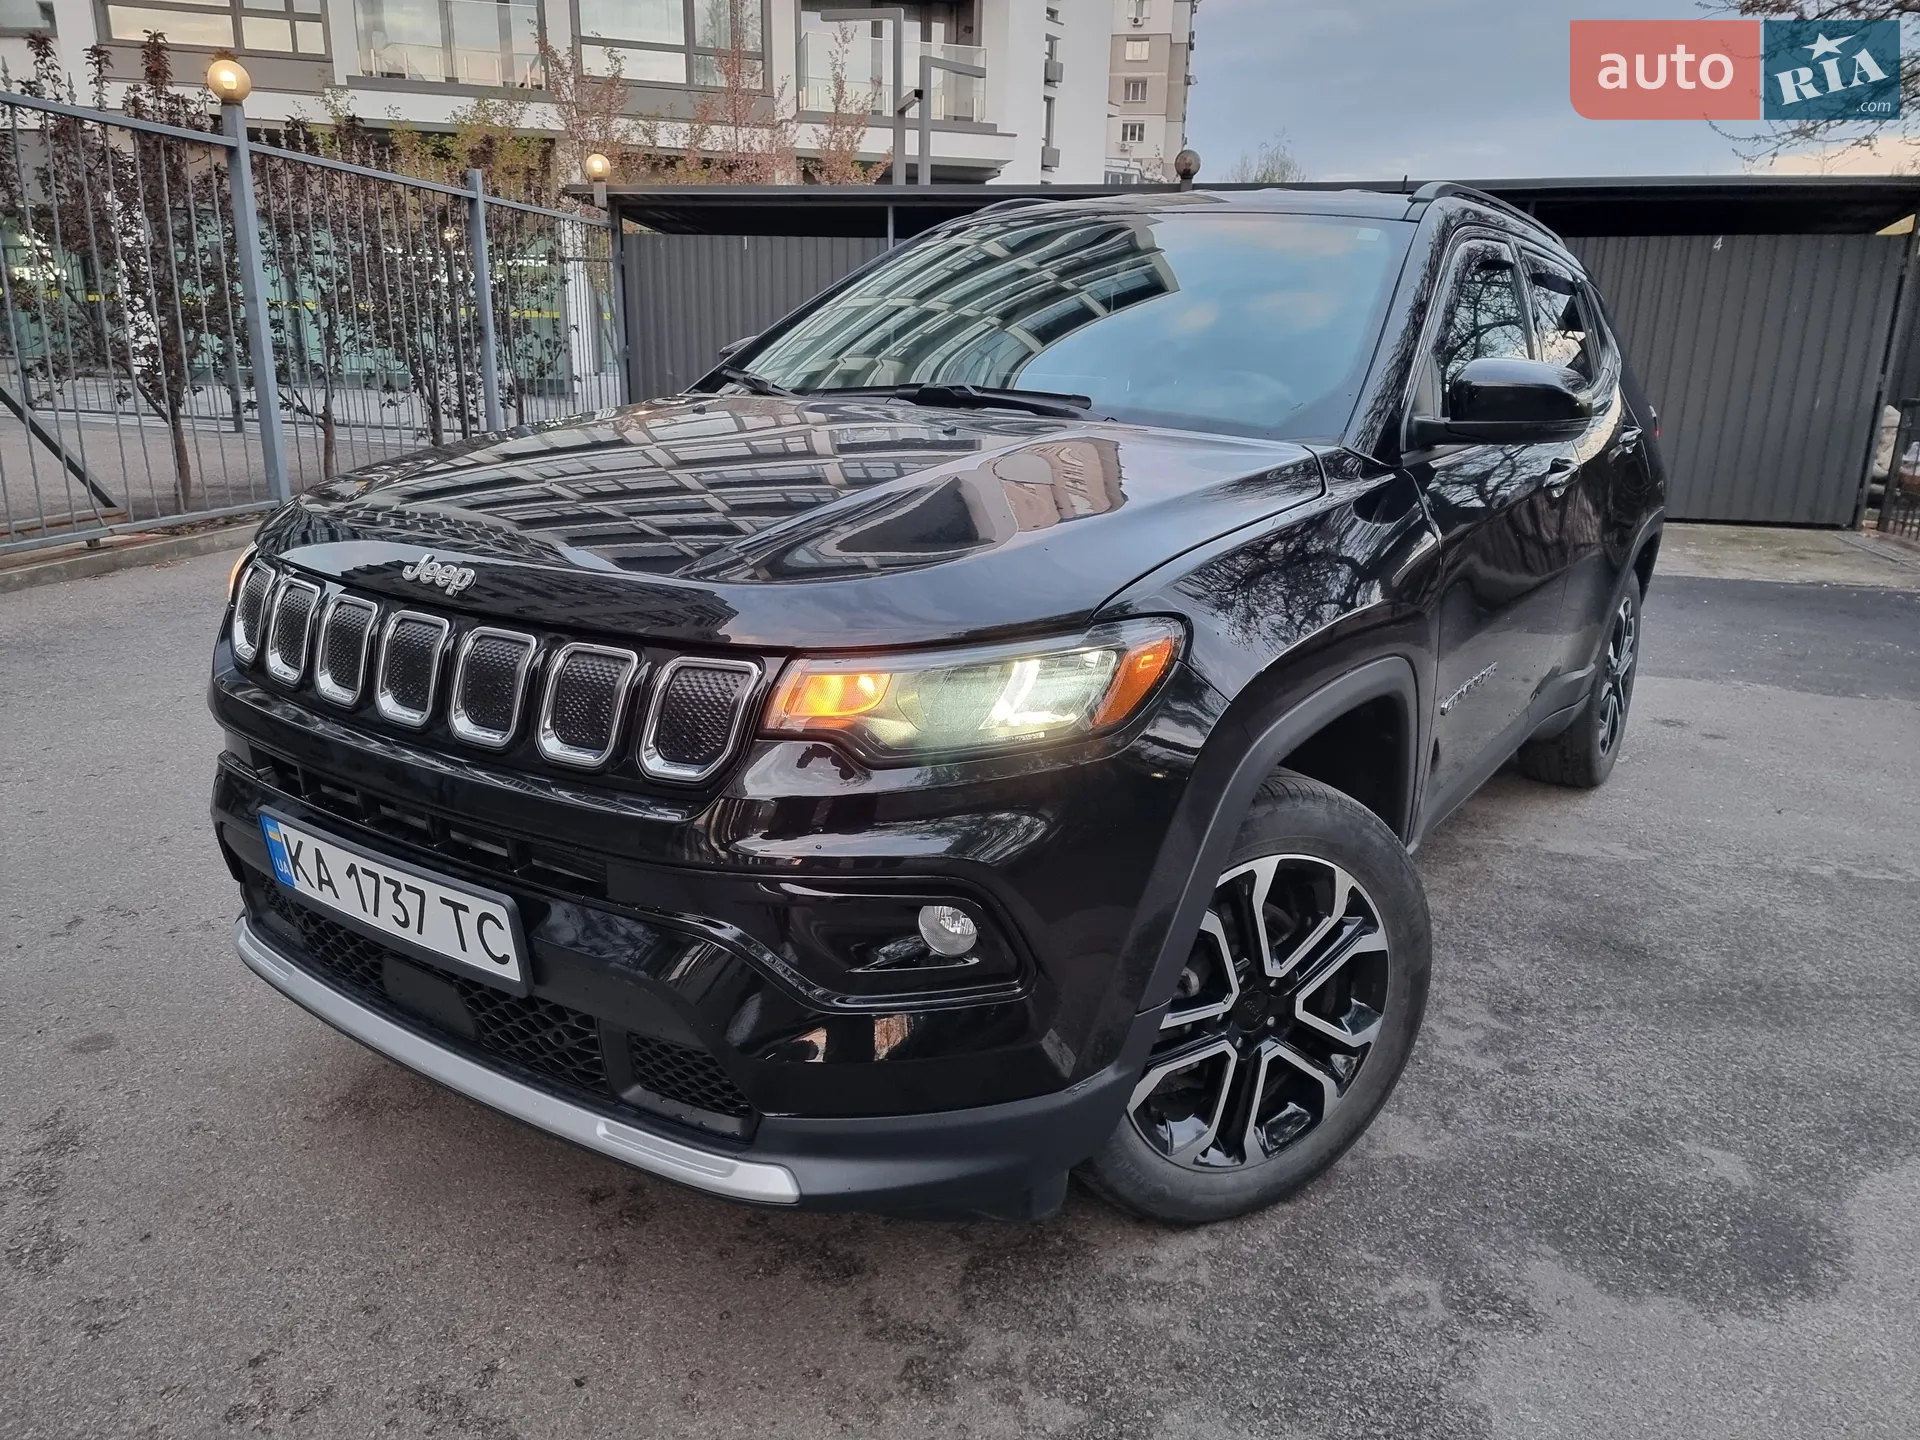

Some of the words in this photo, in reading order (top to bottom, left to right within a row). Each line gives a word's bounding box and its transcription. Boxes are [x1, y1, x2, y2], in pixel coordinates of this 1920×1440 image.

[1713, 235, 1723, 252] 4
[402, 553, 477, 597] Jeep
[275, 857, 291, 876] UA
[283, 832, 340, 900] KA
[345, 862, 427, 936] 1737
[439, 896, 511, 966] TC
